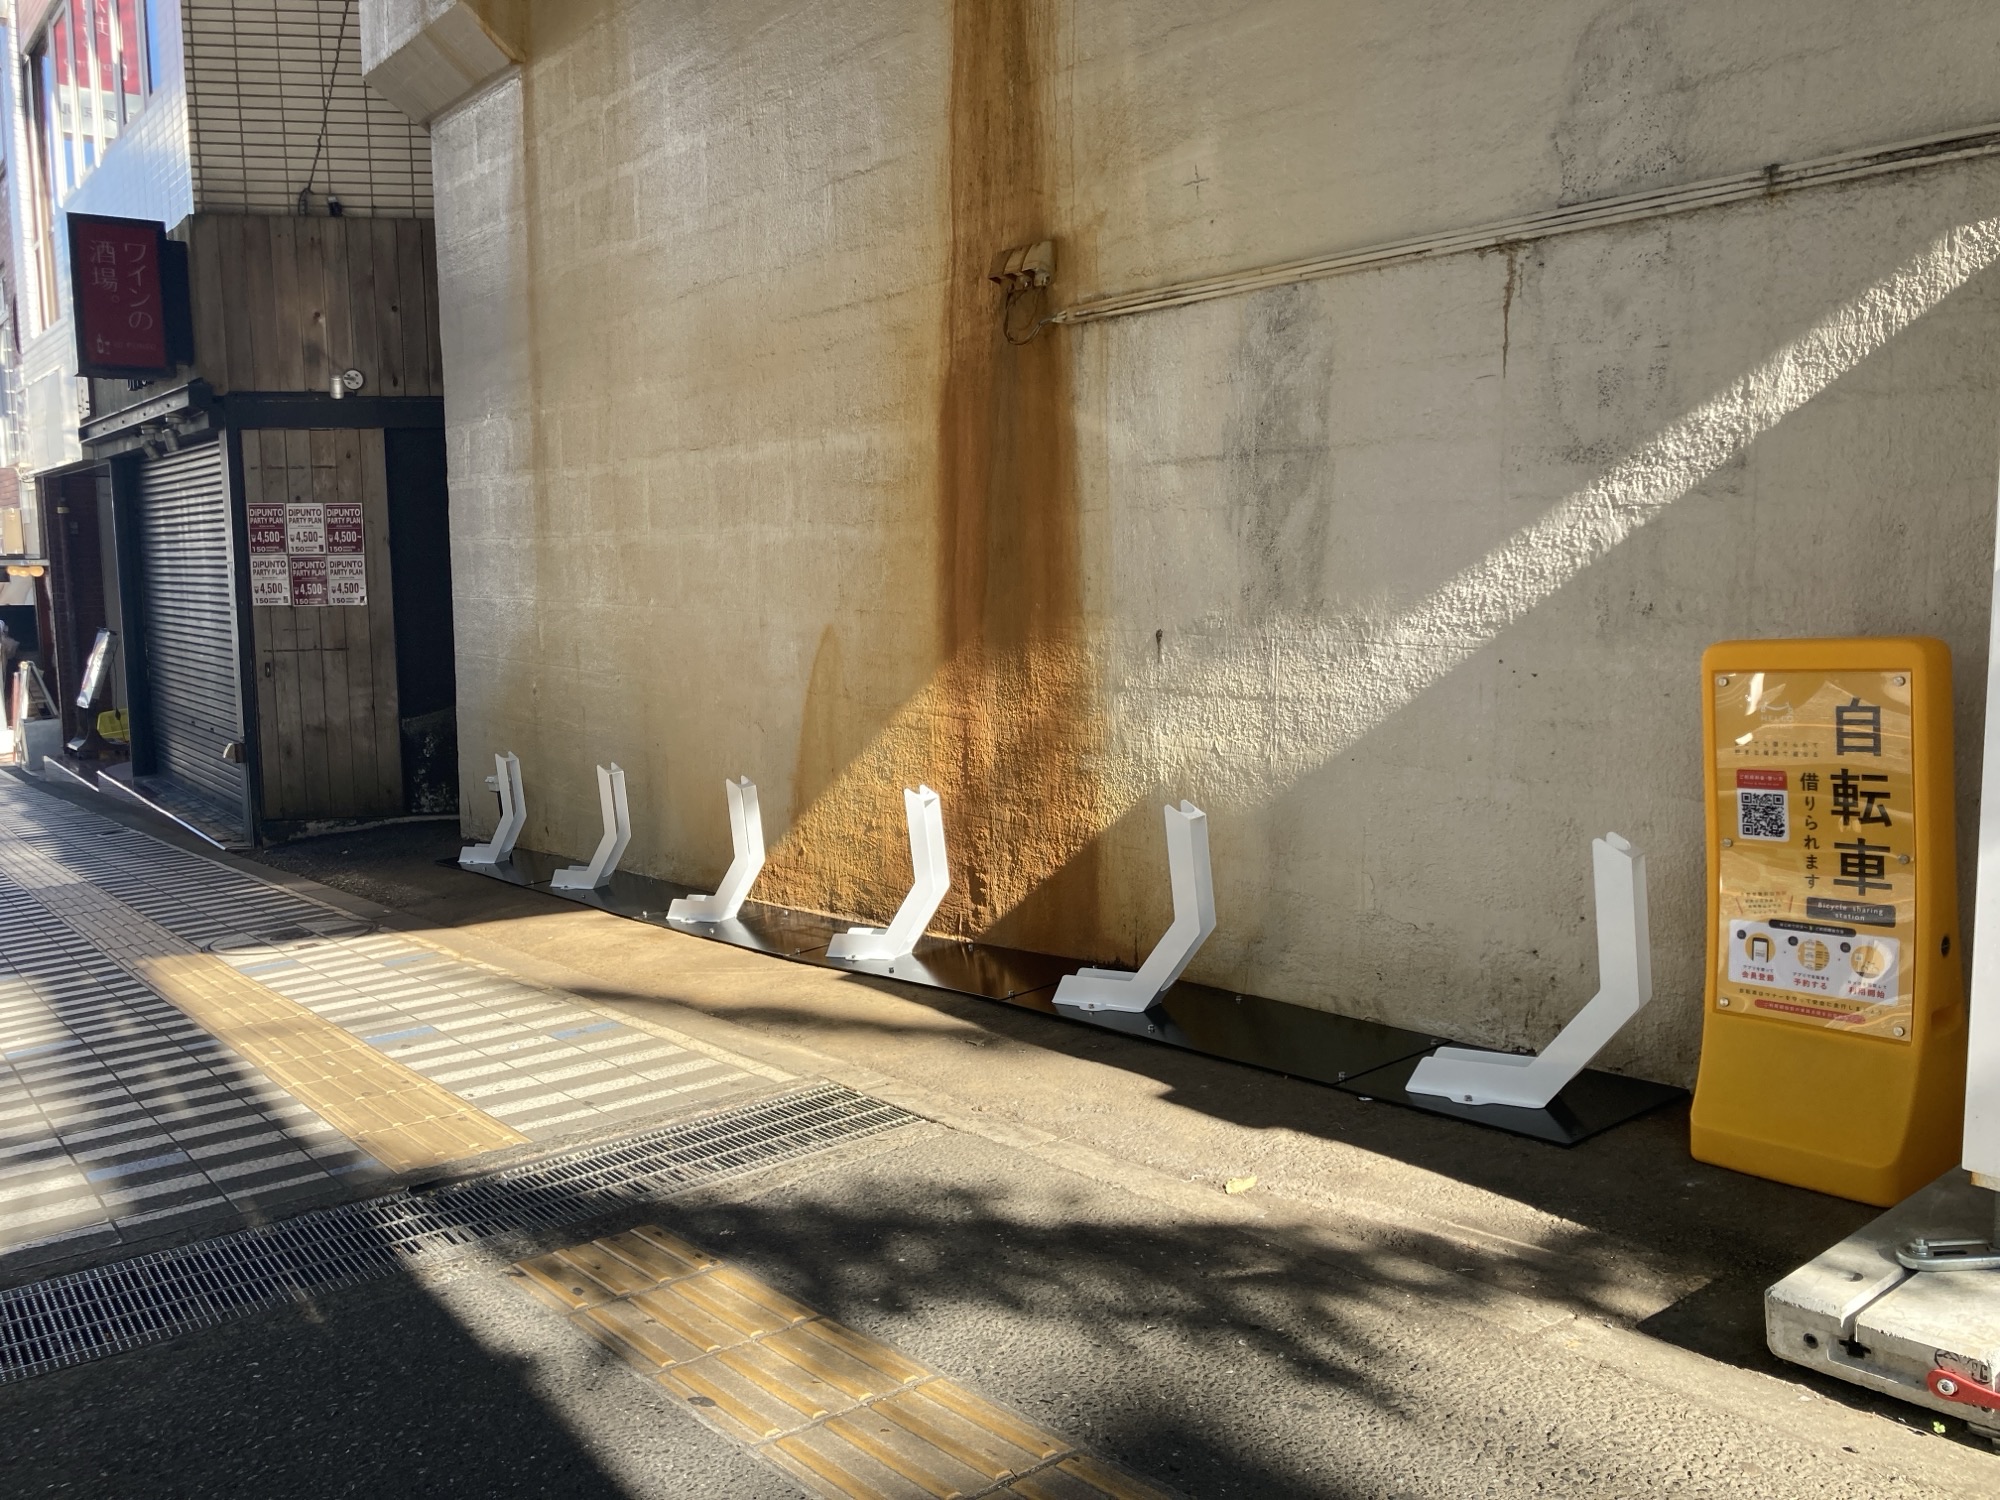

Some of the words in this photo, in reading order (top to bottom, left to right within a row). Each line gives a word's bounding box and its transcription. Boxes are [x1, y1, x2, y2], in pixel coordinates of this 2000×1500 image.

[124, 242, 153, 331] ワインの
[250, 517, 268, 525] PARTY
[268, 517, 284, 525] PLAN
[288, 517, 306, 525] PARTY
[307, 517, 322, 525] PLAN
[327, 517, 345, 525] PARTY
[346, 517, 360, 525] PLAN
[252, 568, 271, 576] PARTY
[271, 568, 287, 576] PLAN
[292, 569, 310, 577] PARTY
[310, 569, 326, 577] PLAN
[330, 568, 348, 576] PARTY
[348, 568, 363, 576] PLAN
[1830, 697, 1893, 897] 自転車
[1800, 772, 1820, 889] 借りられます
[1817, 901, 1848, 911] Bicycle
[1852, 905, 1884, 917] sharing
[1835, 911, 1865, 922] station
[1741, 970, 1775, 982] 会員登録
[1793, 977, 1828, 990] 予約する
